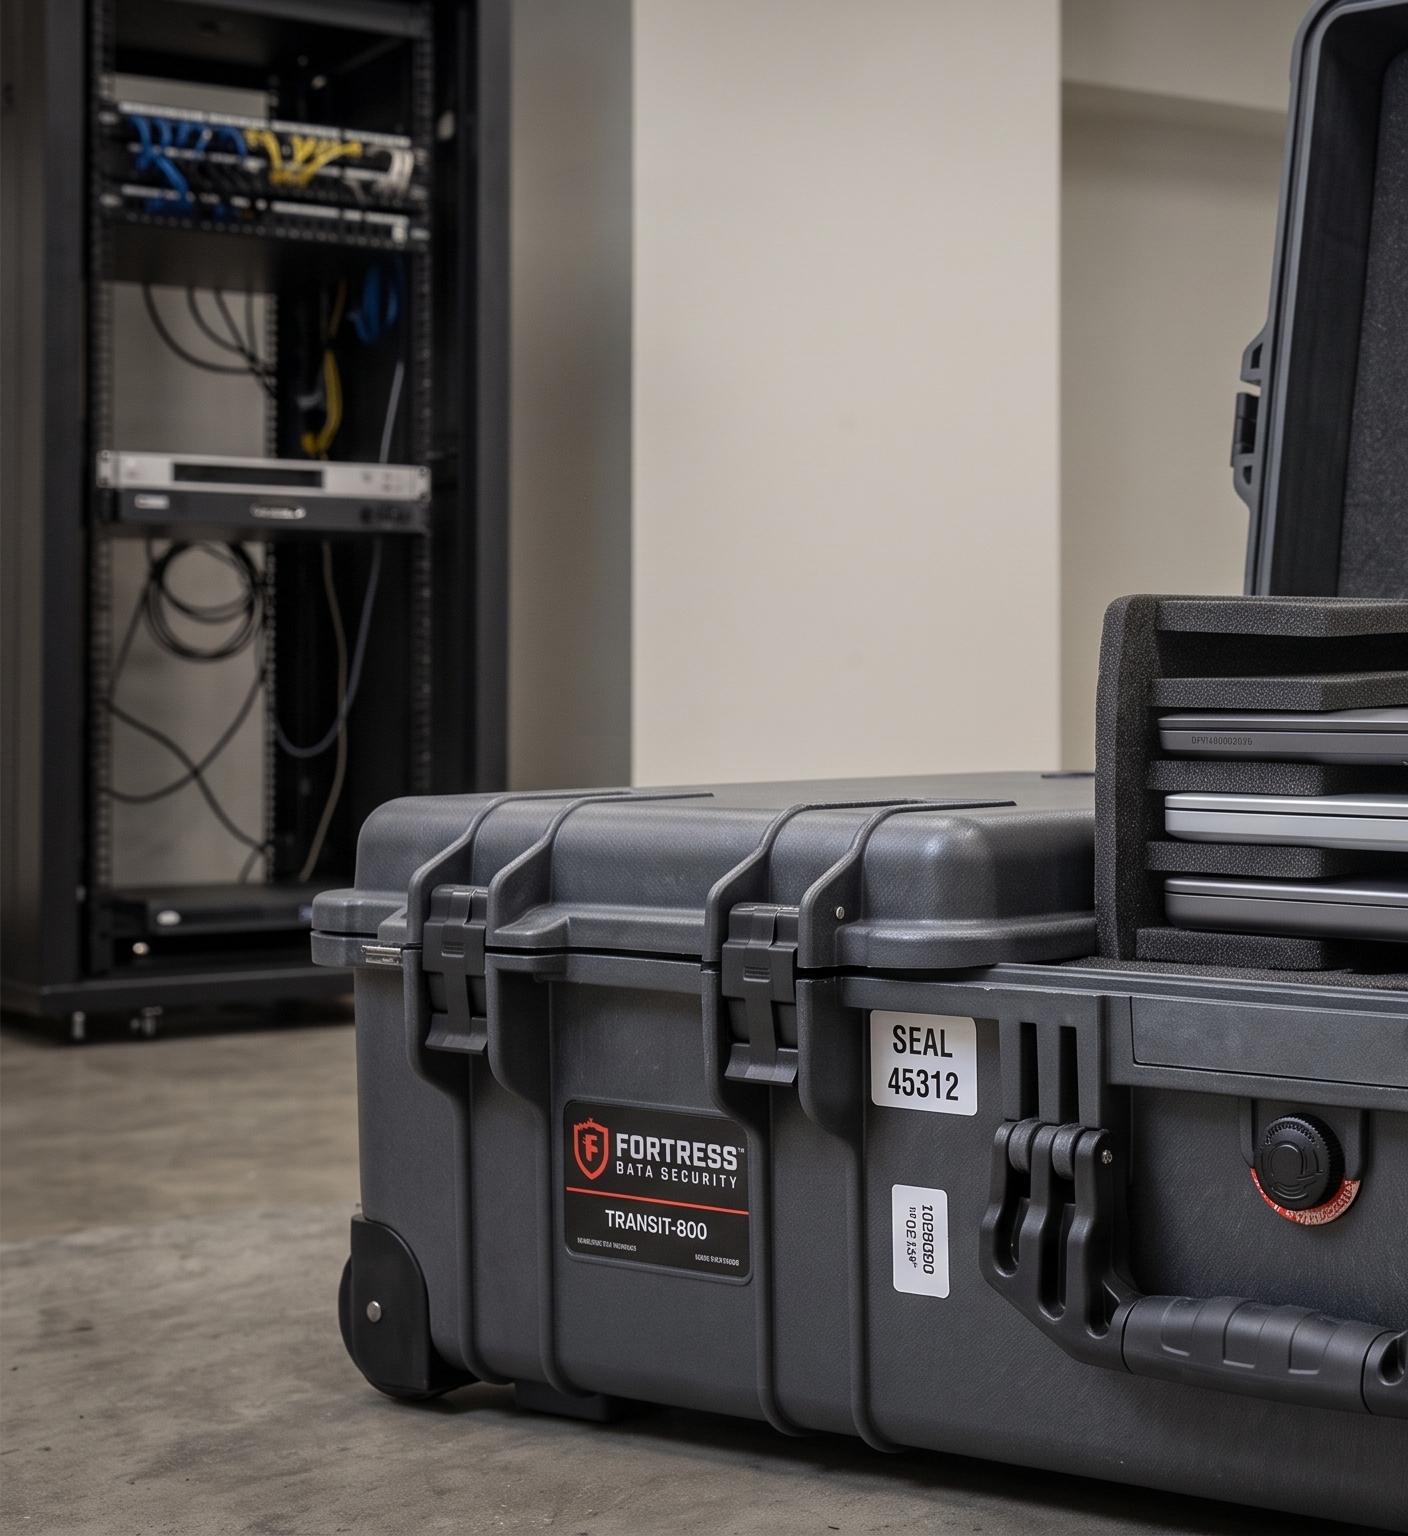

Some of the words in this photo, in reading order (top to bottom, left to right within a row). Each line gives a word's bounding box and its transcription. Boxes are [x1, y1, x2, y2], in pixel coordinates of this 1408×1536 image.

[892, 1024, 953, 1058] SEAL
[888, 1067, 959, 1101] 45312
[616, 1133, 738, 1171] FORTRESS
[661, 1167, 737, 1189] SECURITY
[605, 1209, 708, 1240] TRANSIT-800
